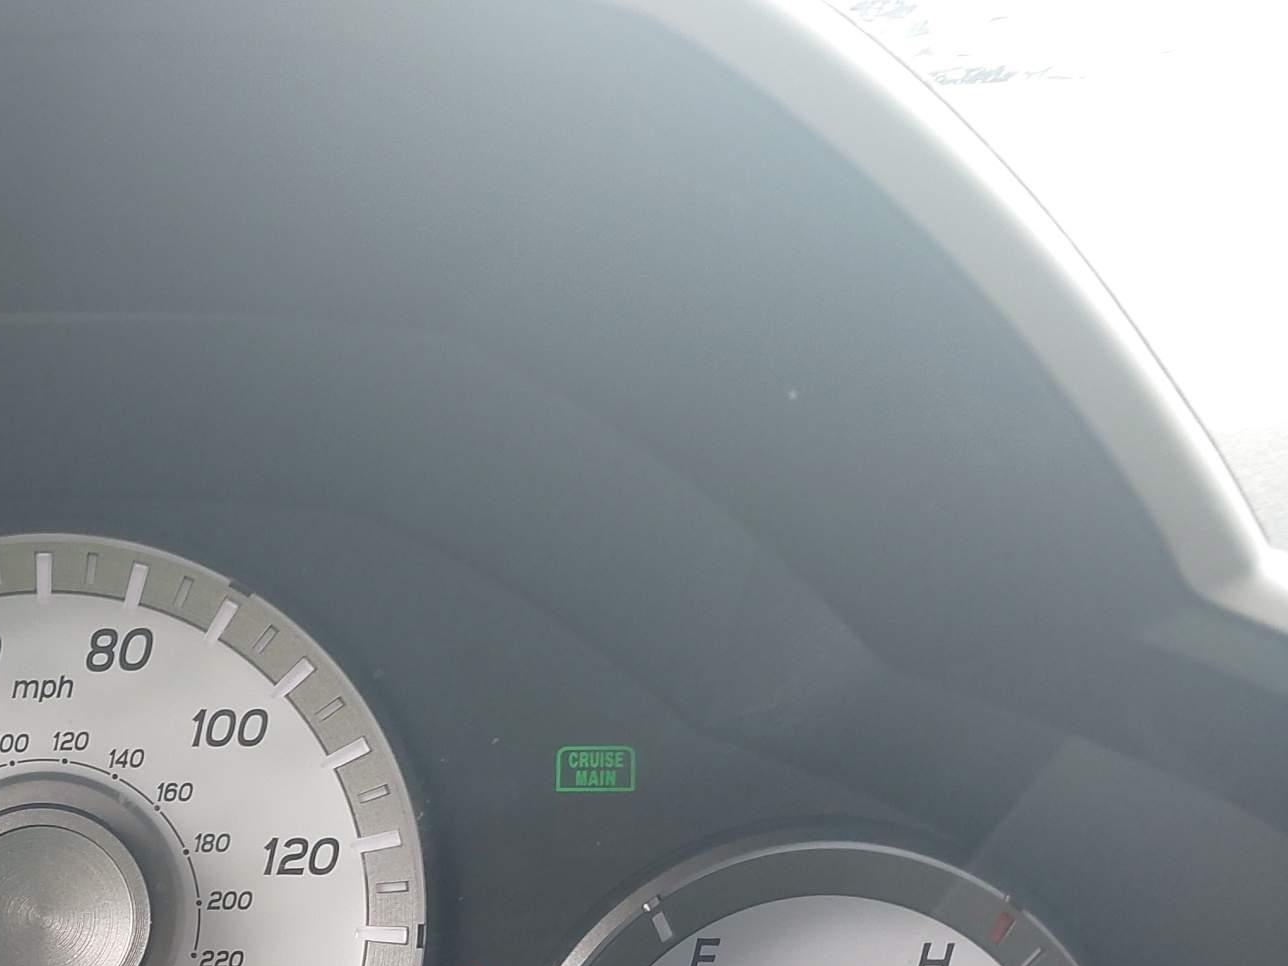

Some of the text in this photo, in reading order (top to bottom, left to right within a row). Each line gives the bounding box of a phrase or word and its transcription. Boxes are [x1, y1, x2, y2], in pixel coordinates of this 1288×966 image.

[86, 628, 153, 671] 80
[13, 676, 73, 702] mph
[191, 709, 268, 748] 100
[53, 732, 89, 751] 120
[109, 749, 145, 769] 140
[568, 751, 624, 768] CRUISE
[576, 770, 616, 786] MAIN
[156, 782, 193, 803] 160
[194, 834, 230, 853] 180
[263, 837, 339, 875] 120
[207, 892, 252, 910] 200
